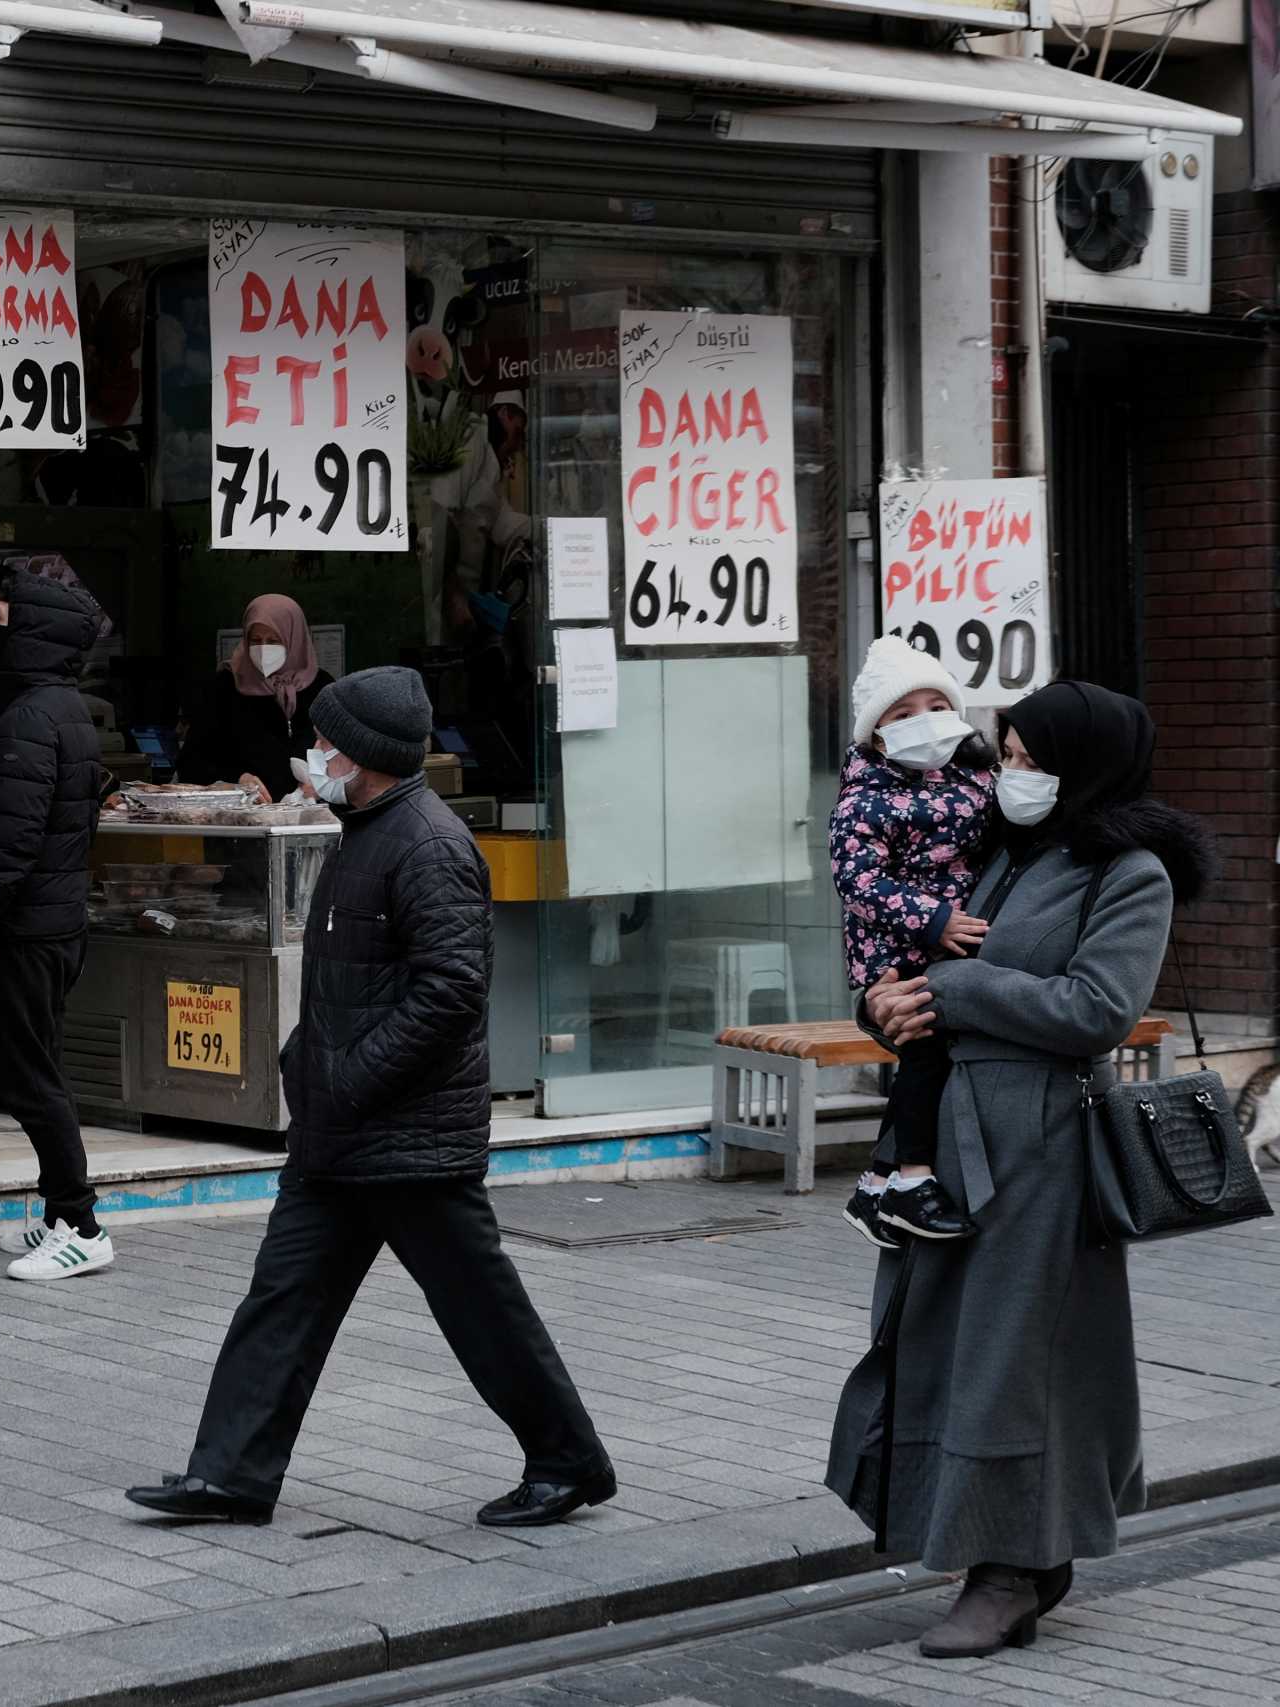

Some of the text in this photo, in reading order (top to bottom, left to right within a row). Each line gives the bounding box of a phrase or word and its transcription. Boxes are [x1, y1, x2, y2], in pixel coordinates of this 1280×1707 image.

[240, 271, 389, 341] DANA
[485, 278, 520, 299] ucuz
[696, 324, 750, 351] DÜŞTÜ
[225, 342, 349, 428] ETİ
[497, 352, 549, 381] Kendi
[637, 386, 769, 448] DANA
[215, 441, 392, 538] 74.90
[907, 498, 1032, 552] BÜTÜN
[629, 553, 770, 633] 64.90
[885, 552, 1004, 614] PİLİÇ
[168, 995, 232, 1013] DANA DÖNER
[179, 1010, 214, 1025] PAKETİ
[173, 1030, 222, 1064] 15.99
